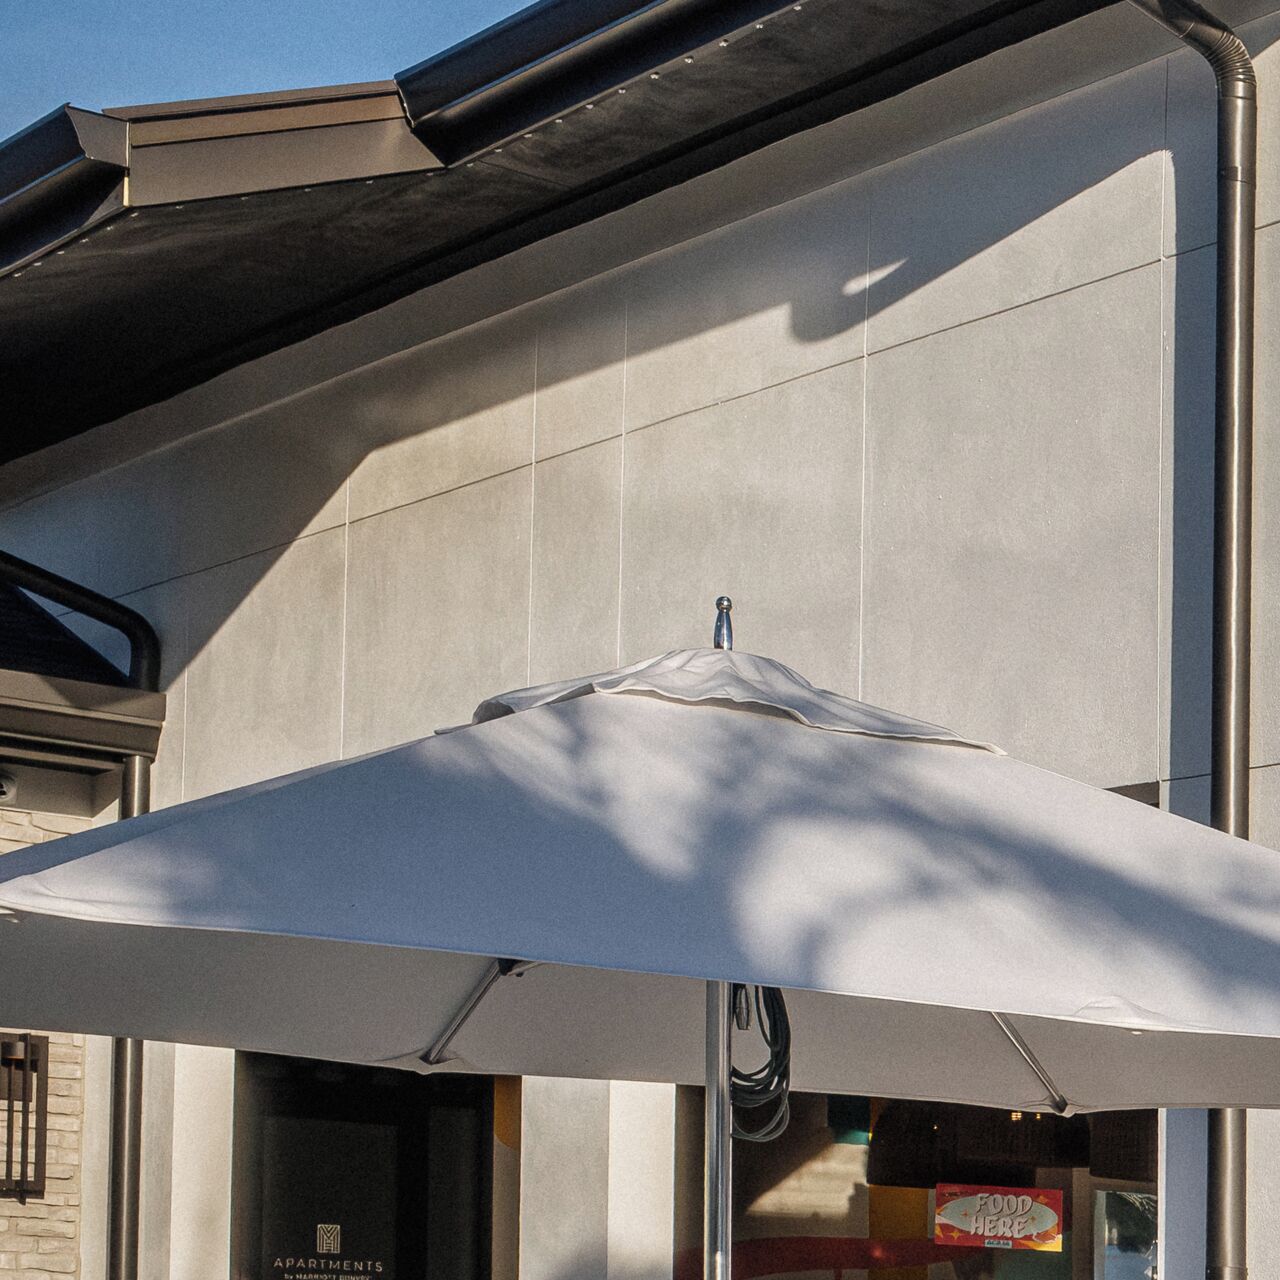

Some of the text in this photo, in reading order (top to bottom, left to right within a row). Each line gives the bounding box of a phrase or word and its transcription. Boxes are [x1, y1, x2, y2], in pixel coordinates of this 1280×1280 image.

[976, 1193, 1034, 1217] FOOD
[970, 1215, 1029, 1239] HERE
[273, 1257, 383, 1272] APARTMENTS
